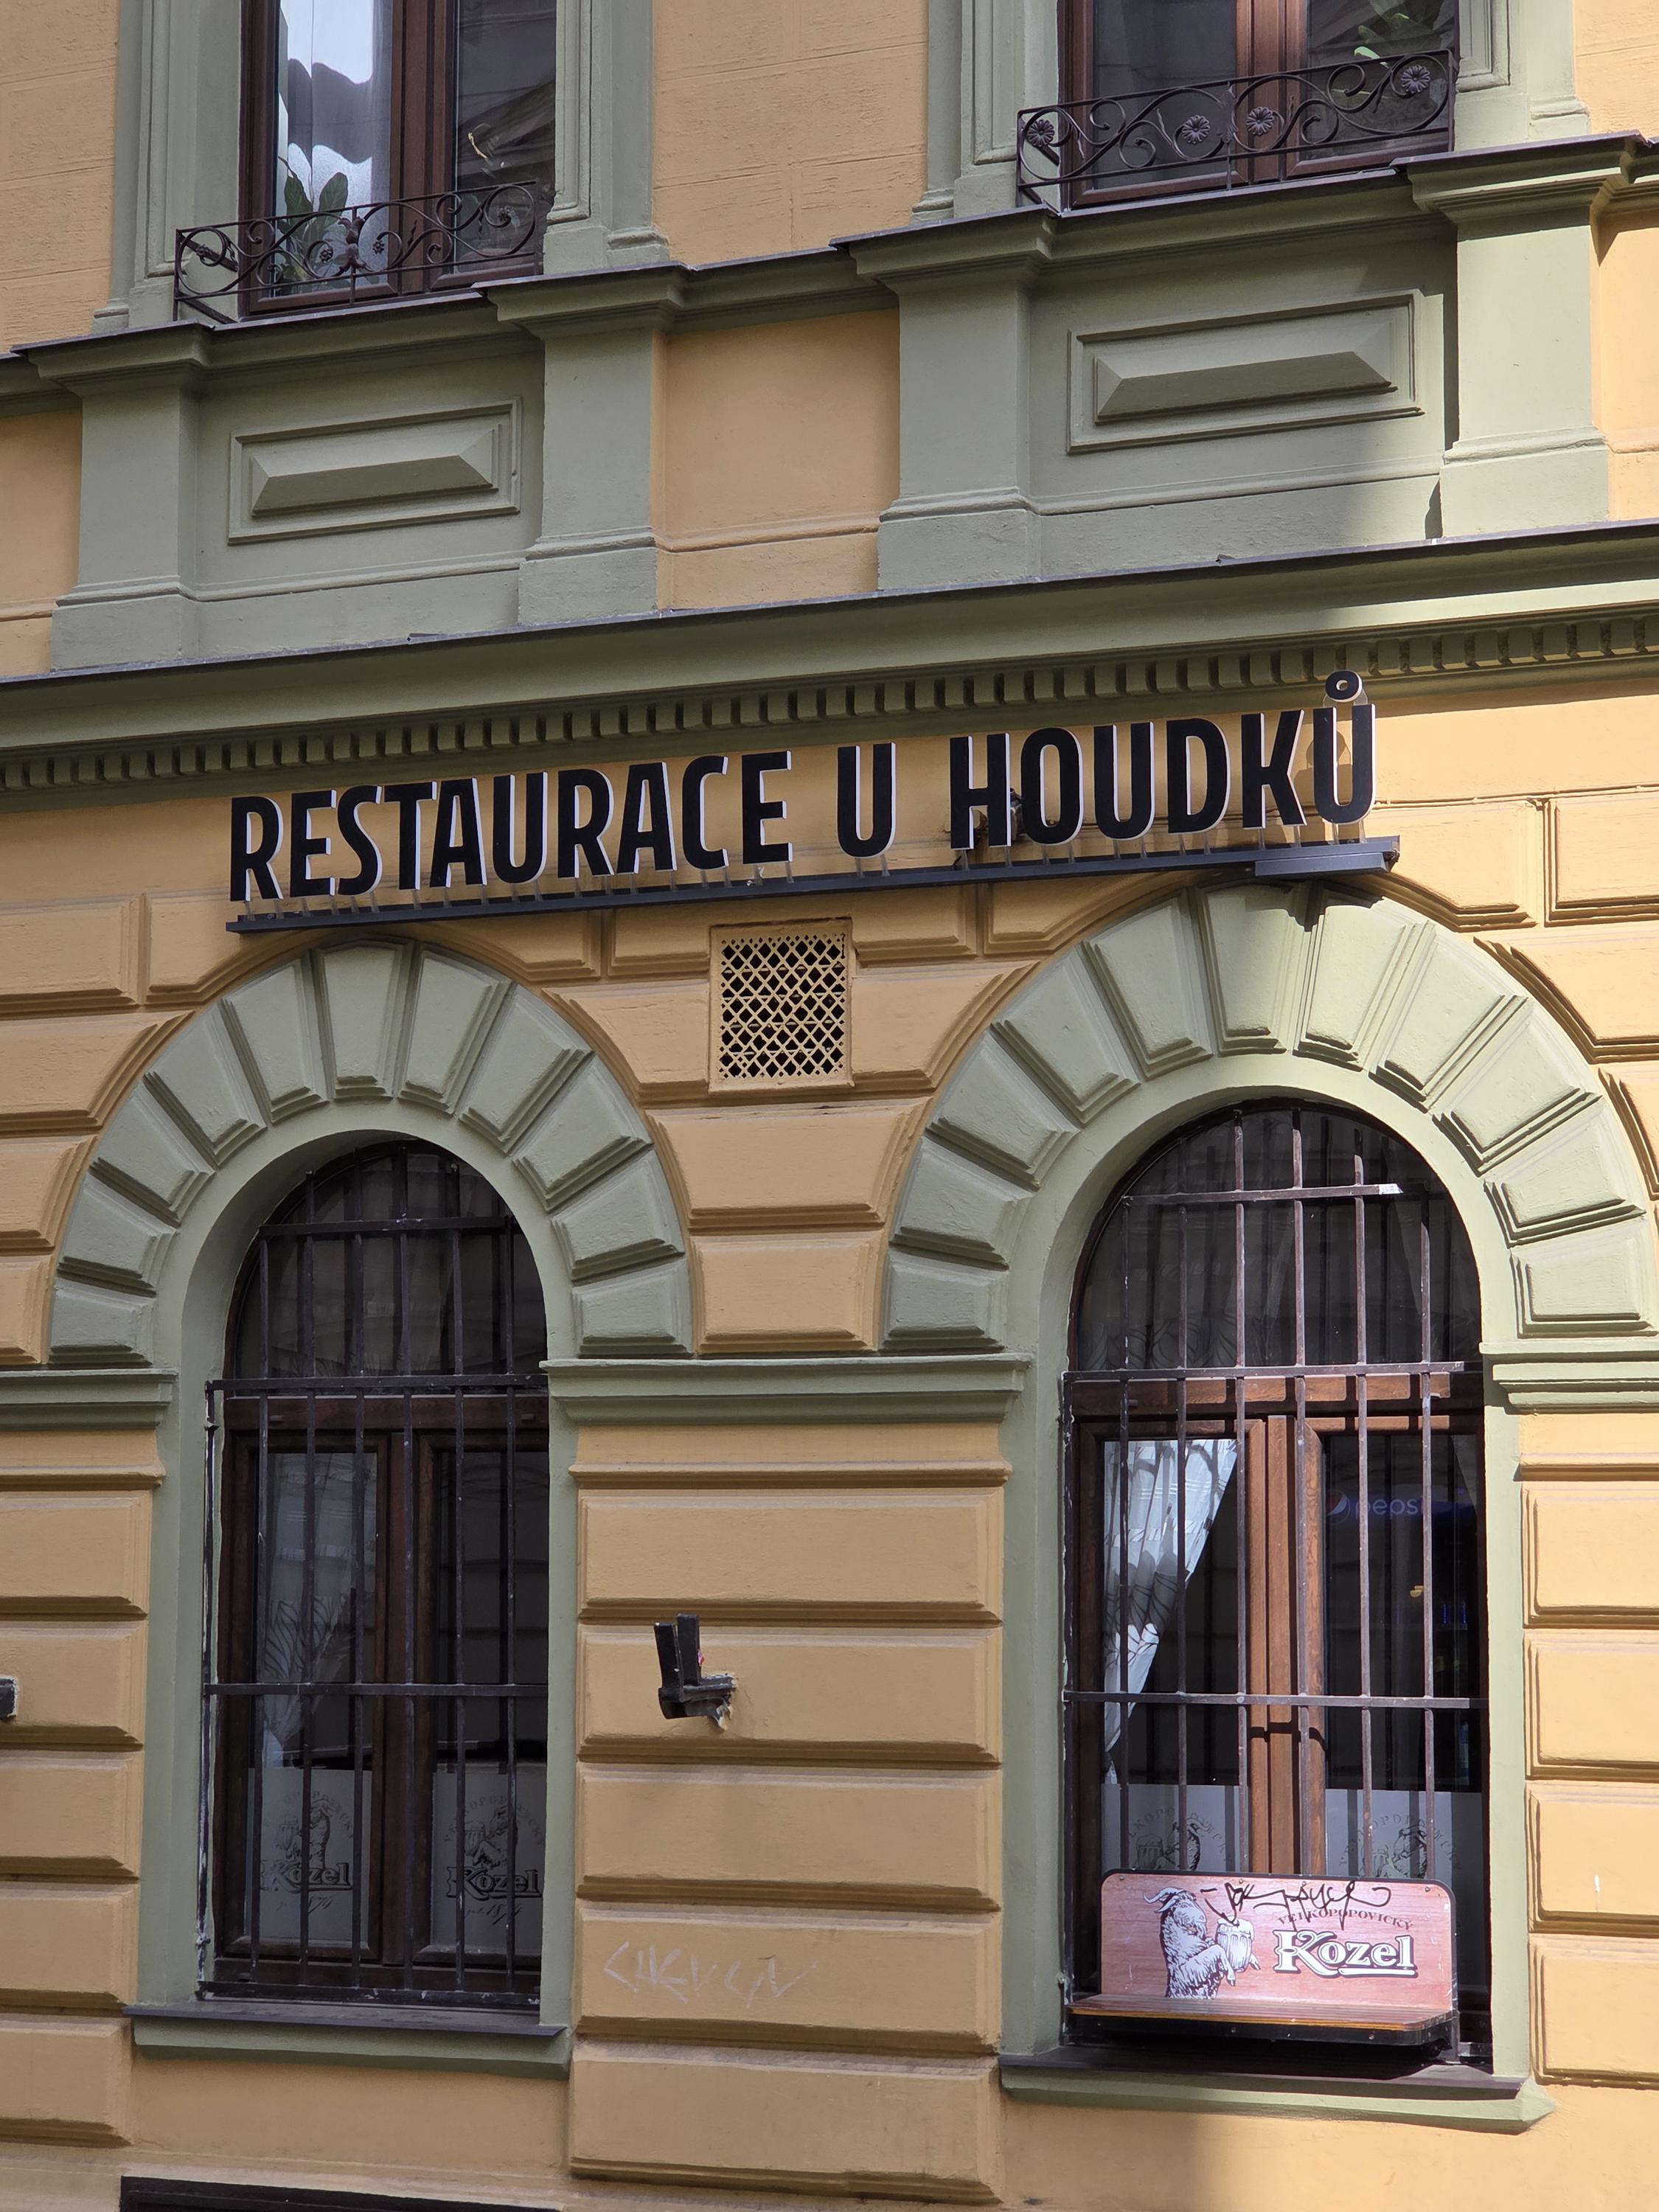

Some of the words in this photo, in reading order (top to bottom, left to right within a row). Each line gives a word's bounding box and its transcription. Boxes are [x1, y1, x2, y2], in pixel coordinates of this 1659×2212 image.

[230, 749, 793, 902] RESTAURACE
[837, 742, 897, 859] U
[949, 669, 1376, 851] HOUDKŮ
[1355, 1498, 1425, 1520] eps
[1273, 1929, 1419, 1978] Kozel
